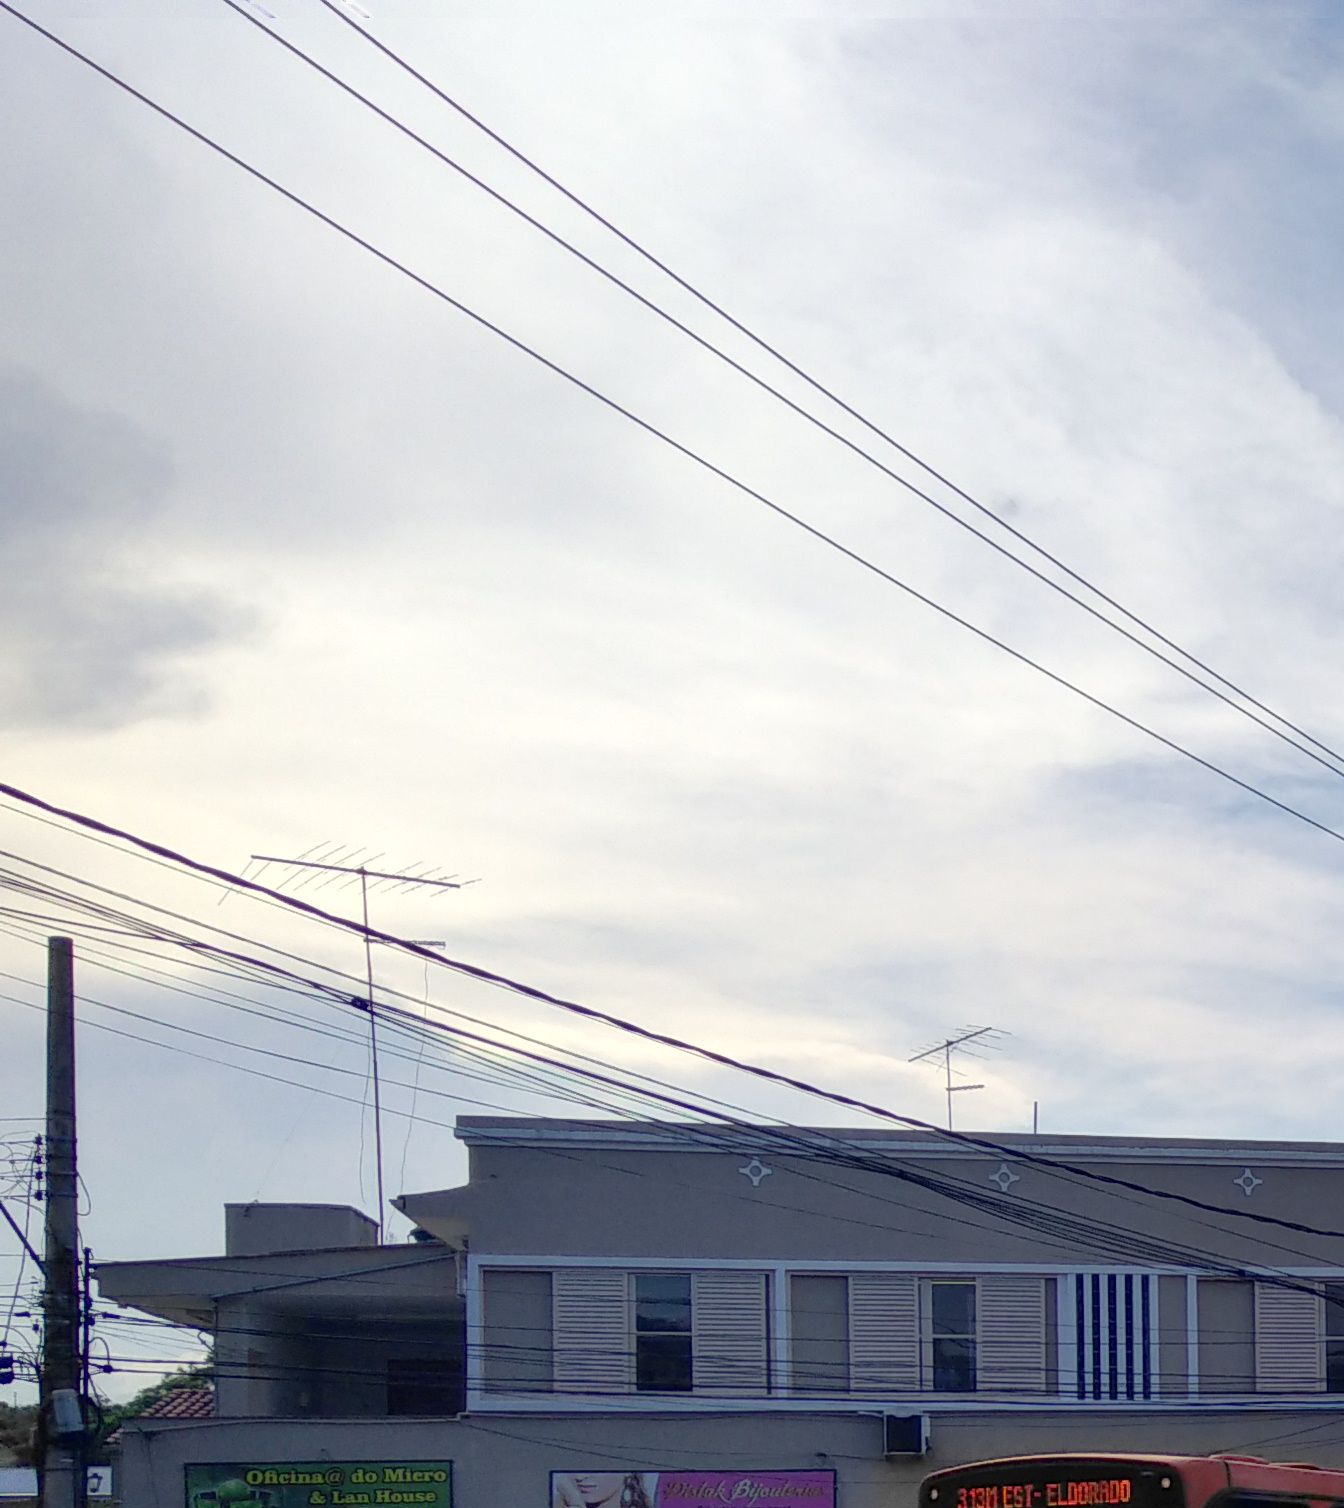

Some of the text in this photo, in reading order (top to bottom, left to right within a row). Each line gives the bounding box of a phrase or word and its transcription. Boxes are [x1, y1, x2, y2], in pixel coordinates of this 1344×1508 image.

[246, 1468, 447, 1486] Oficina@ do Micro
[310, 1490, 436, 1504] & Lan House
[732, 1478, 824, 1506] Bijouterias
[1046, 1479, 1131, 1507] ELDORADO
